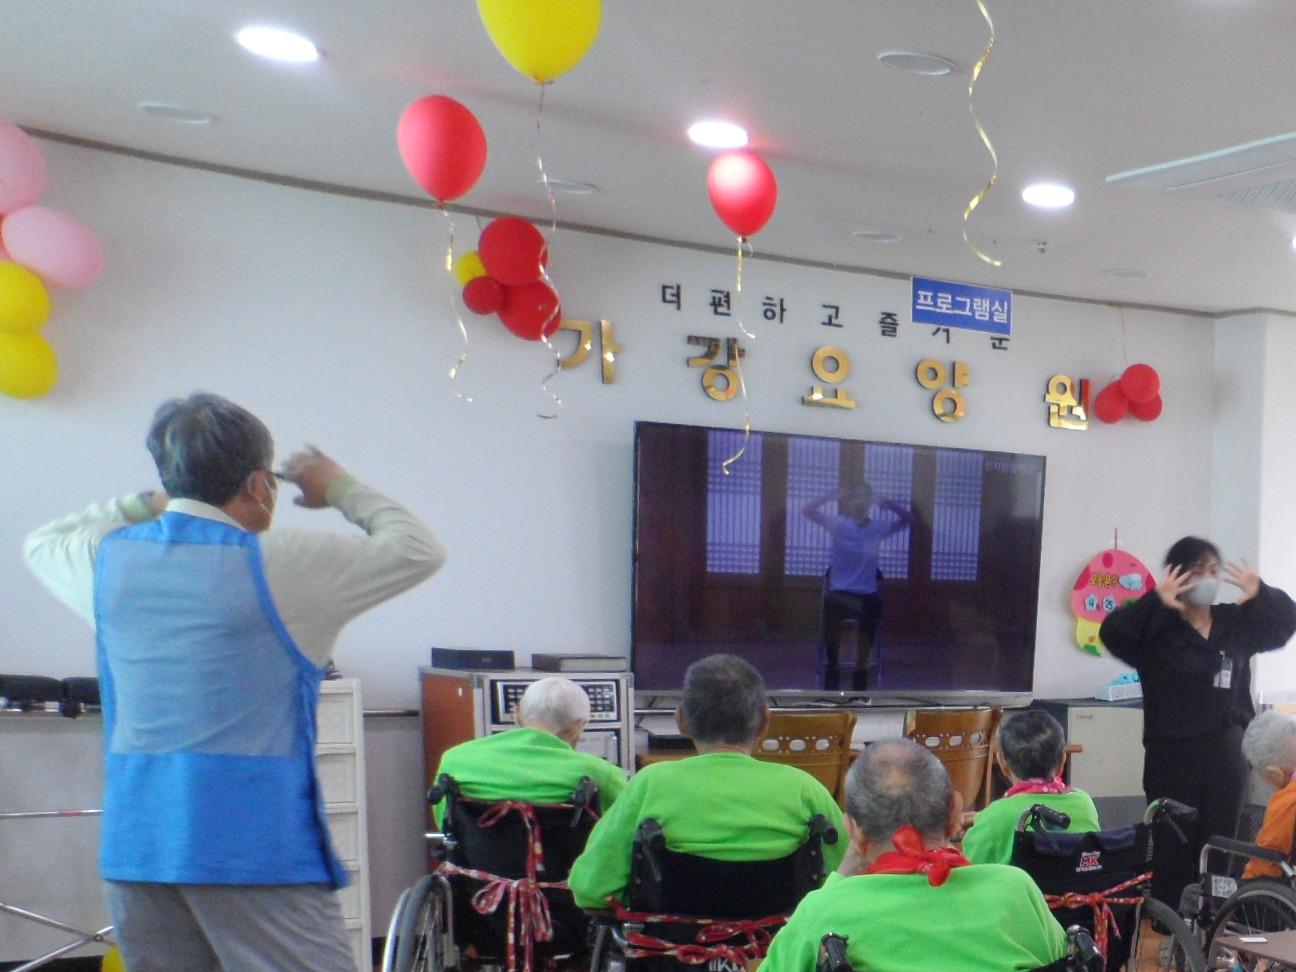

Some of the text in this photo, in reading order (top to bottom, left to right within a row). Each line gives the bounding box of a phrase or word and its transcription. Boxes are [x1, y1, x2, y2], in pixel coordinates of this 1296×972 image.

[661, 284, 681, 311] 더
[915, 290, 1008, 324] 프로그램실
[560, 318, 1089, 431] 가강요양원
